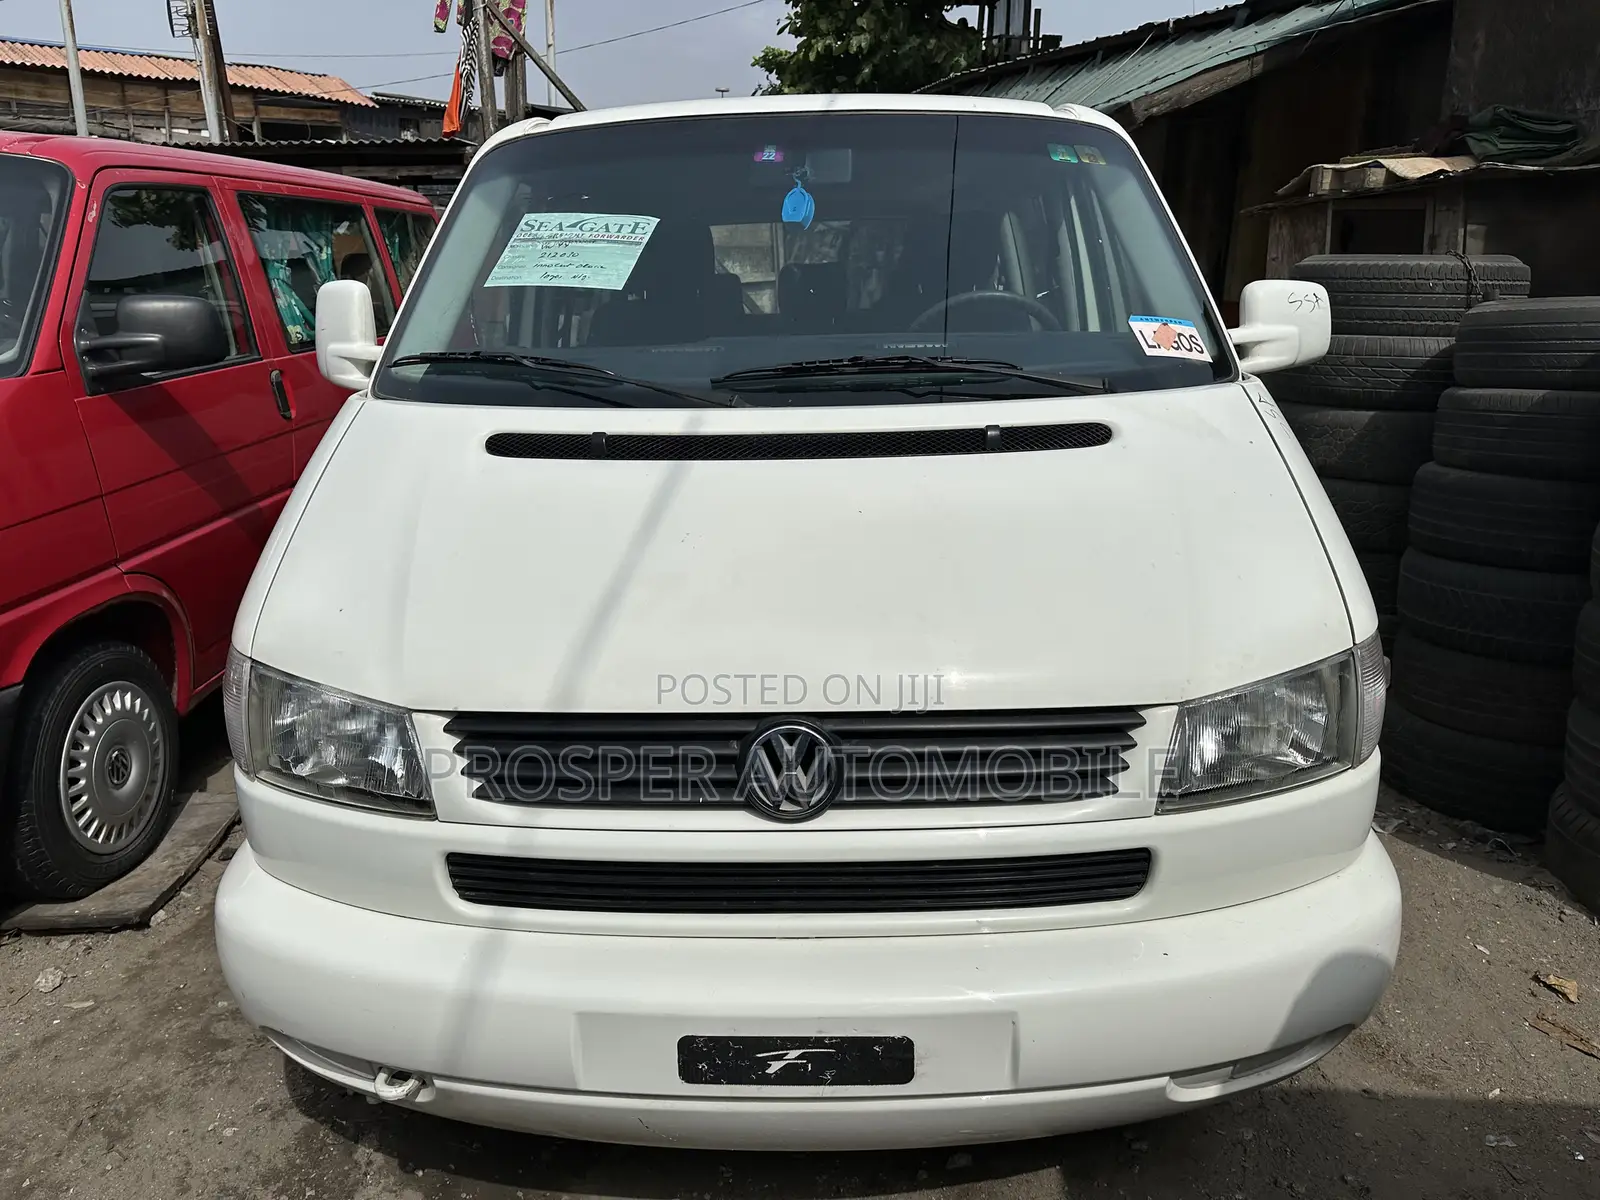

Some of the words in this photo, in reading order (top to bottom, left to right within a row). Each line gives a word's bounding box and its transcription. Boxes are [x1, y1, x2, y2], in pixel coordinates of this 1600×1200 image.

[520, 219, 564, 232] SEA
[578, 221, 650, 235] GATE
[588, 233, 645, 241] FORWARDER
